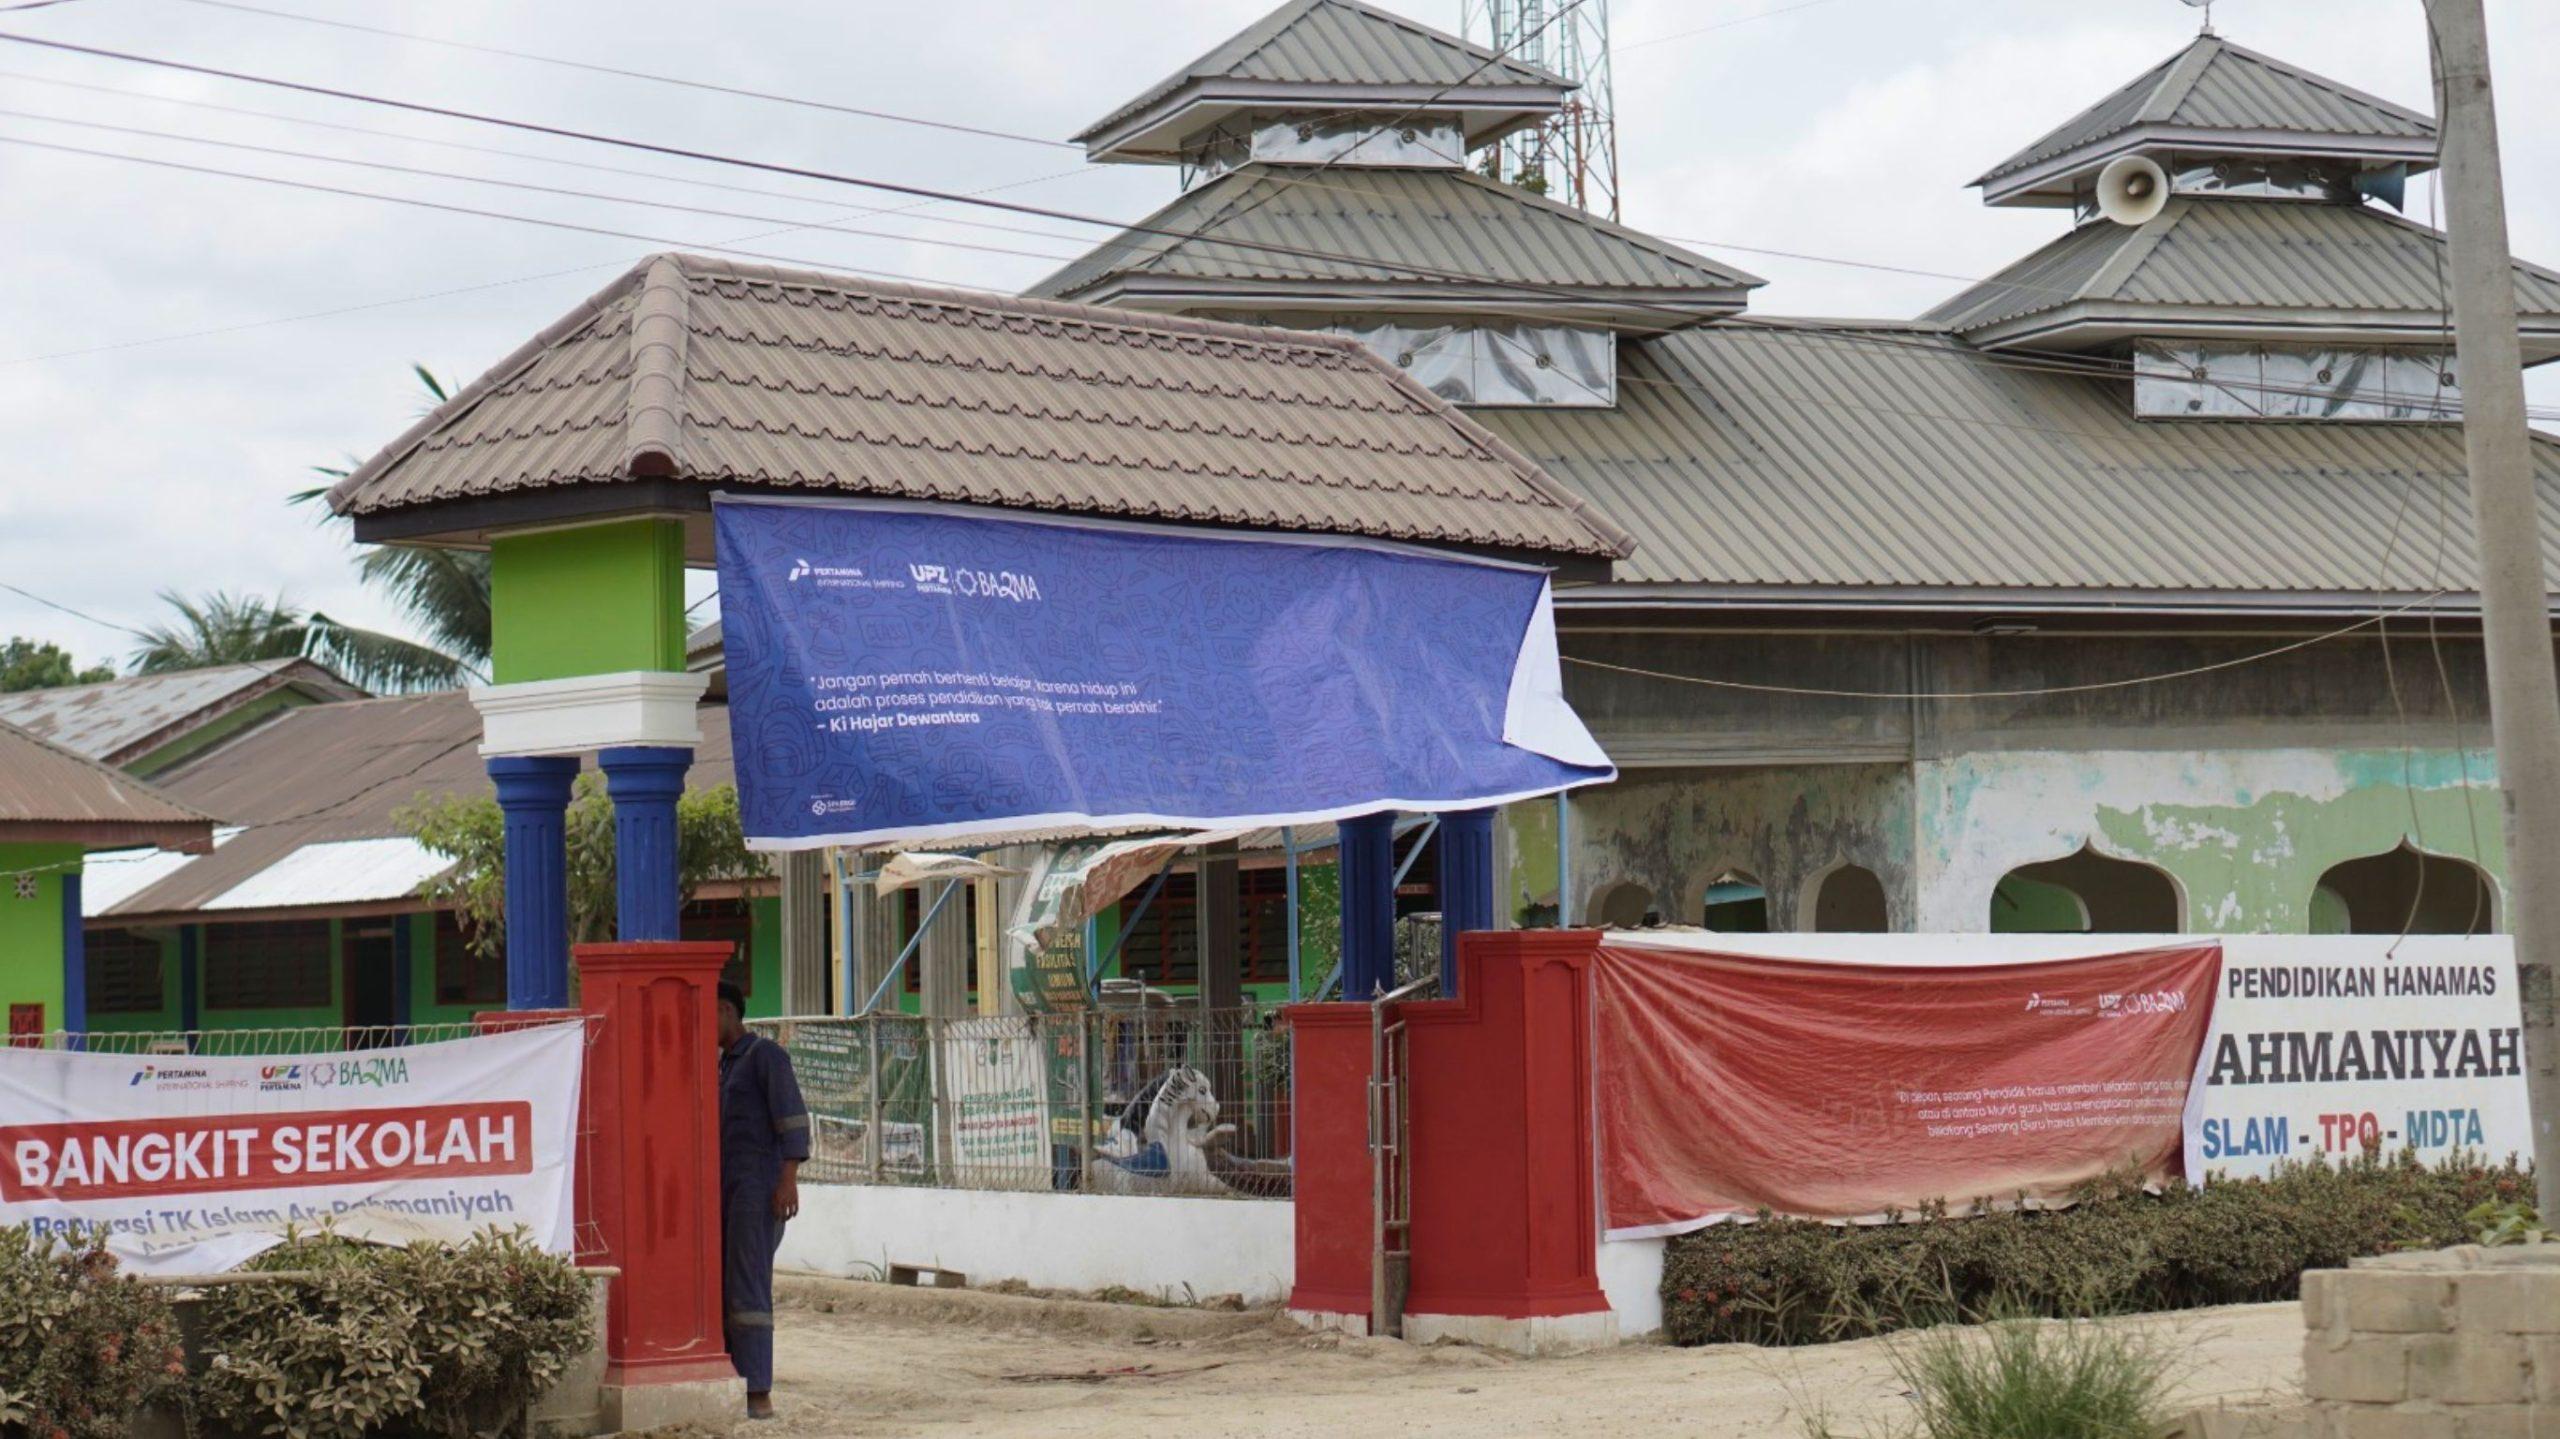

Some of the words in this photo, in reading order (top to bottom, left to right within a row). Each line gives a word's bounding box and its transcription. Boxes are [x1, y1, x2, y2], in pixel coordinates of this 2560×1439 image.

[909, 563, 949, 584] UPZ
[879, 671, 932, 689] pernah
[934, 670, 990, 687] berhenti
[1036, 679, 1080, 694] karena
[1081, 681, 1119, 698] hidup
[1120, 682, 1137, 696] ini
[814, 695, 872, 711] adalah
[874, 693, 926, 710] proses
[929, 690, 1003, 707] pendidikan
[1005, 694, 1036, 712] yang
[1055, 701, 1101, 715] pernah
[830, 717, 847, 732] Ki
[850, 714, 894, 733] Hajar
[897, 711, 980, 727] Dewantara
[2229, 967, 2376, 998] PENDIDIKAN
[2385, 966, 2496, 997] HANAMAS
[157, 1070, 207, 1080] PERTAMINA
[261, 1065, 301, 1080] UPZ
[260, 1083, 302, 1091] PERTAMINA
[2027, 1084, 2056, 1098] harus
[2042, 1100, 2072, 1114] harus
[2203, 1116, 2289, 1159] SLAM
[2406, 1108, 2484, 1148] MDTA
[15, 1128, 259, 1187] BANGKIT
[272, 1115, 515, 1174] SEKOLAH
[159, 1210, 198, 1233] TK
[201, 1206, 282, 1228] Islam
